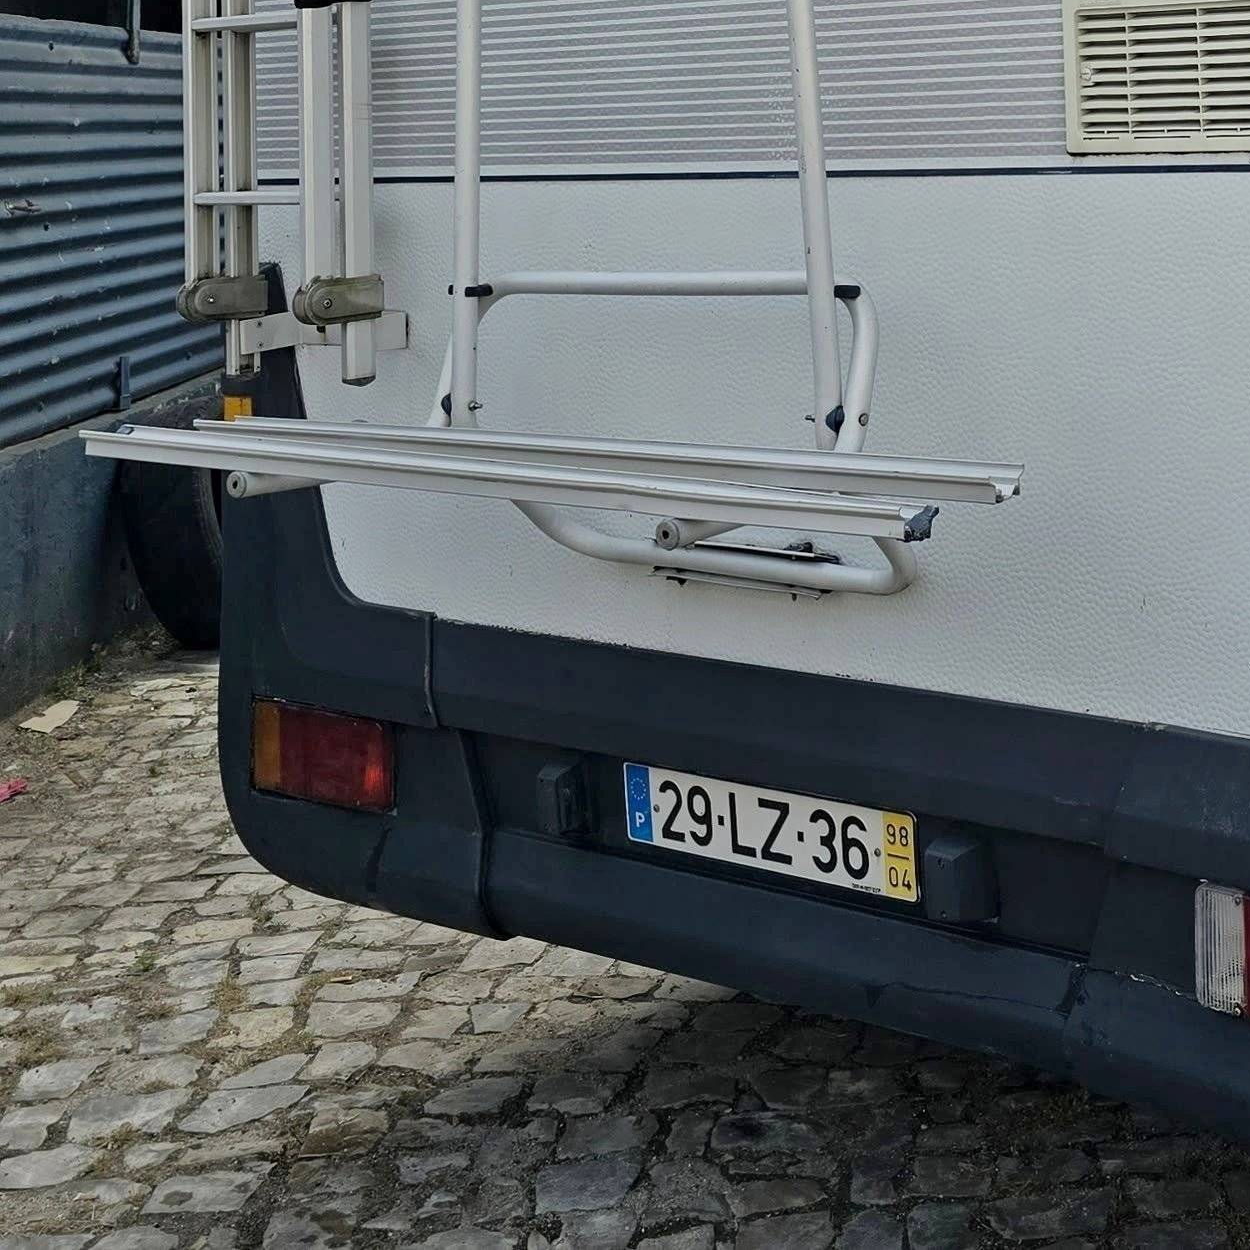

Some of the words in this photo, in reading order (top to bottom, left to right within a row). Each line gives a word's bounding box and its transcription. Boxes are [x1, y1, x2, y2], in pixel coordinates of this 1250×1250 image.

[635, 811, 646, 828] P
[886, 823, 909, 847] 98
[888, 866, 913, 890] 04
